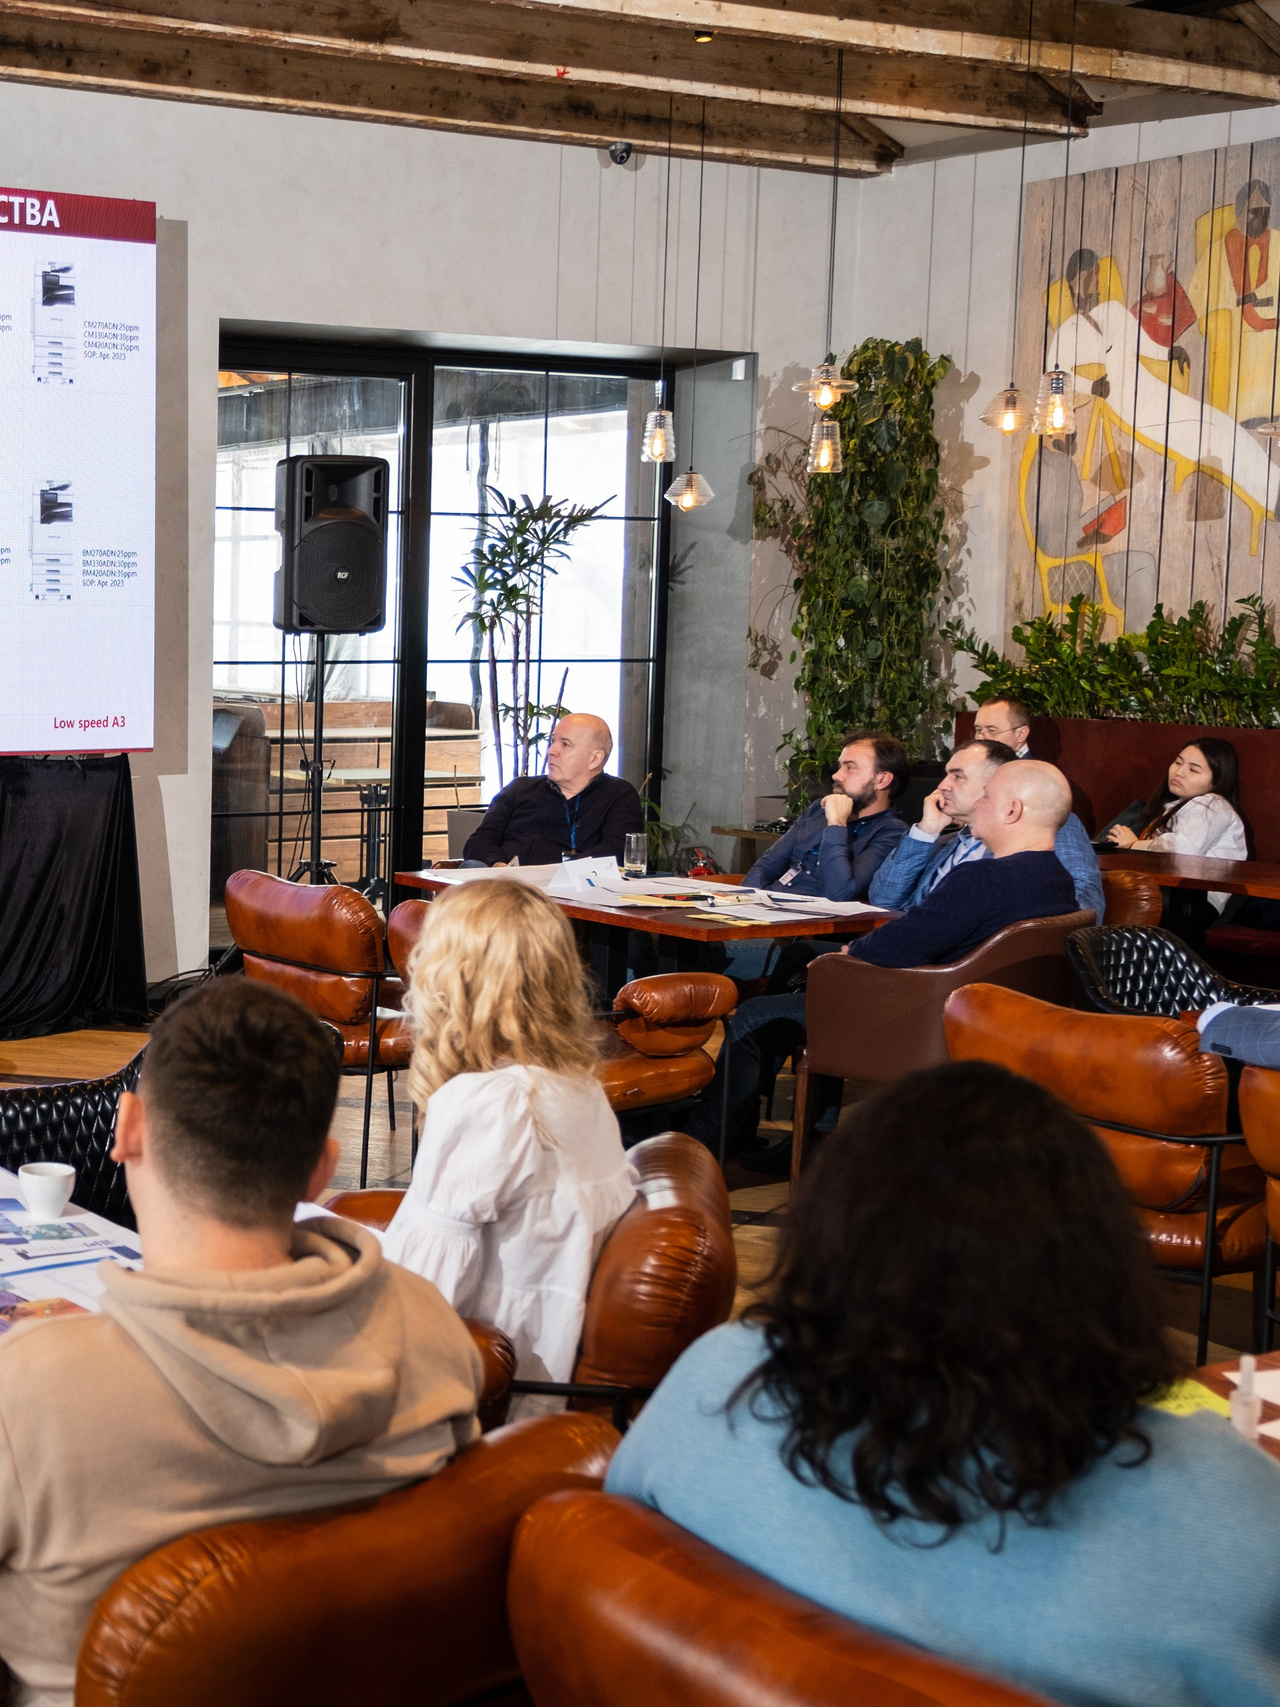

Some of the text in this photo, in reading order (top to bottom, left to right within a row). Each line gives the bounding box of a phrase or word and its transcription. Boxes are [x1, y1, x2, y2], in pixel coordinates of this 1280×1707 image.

[111, 352, 126, 361] 2023
[110, 579, 124, 587] 2023
[53, 716, 126, 732] Low speed A3
